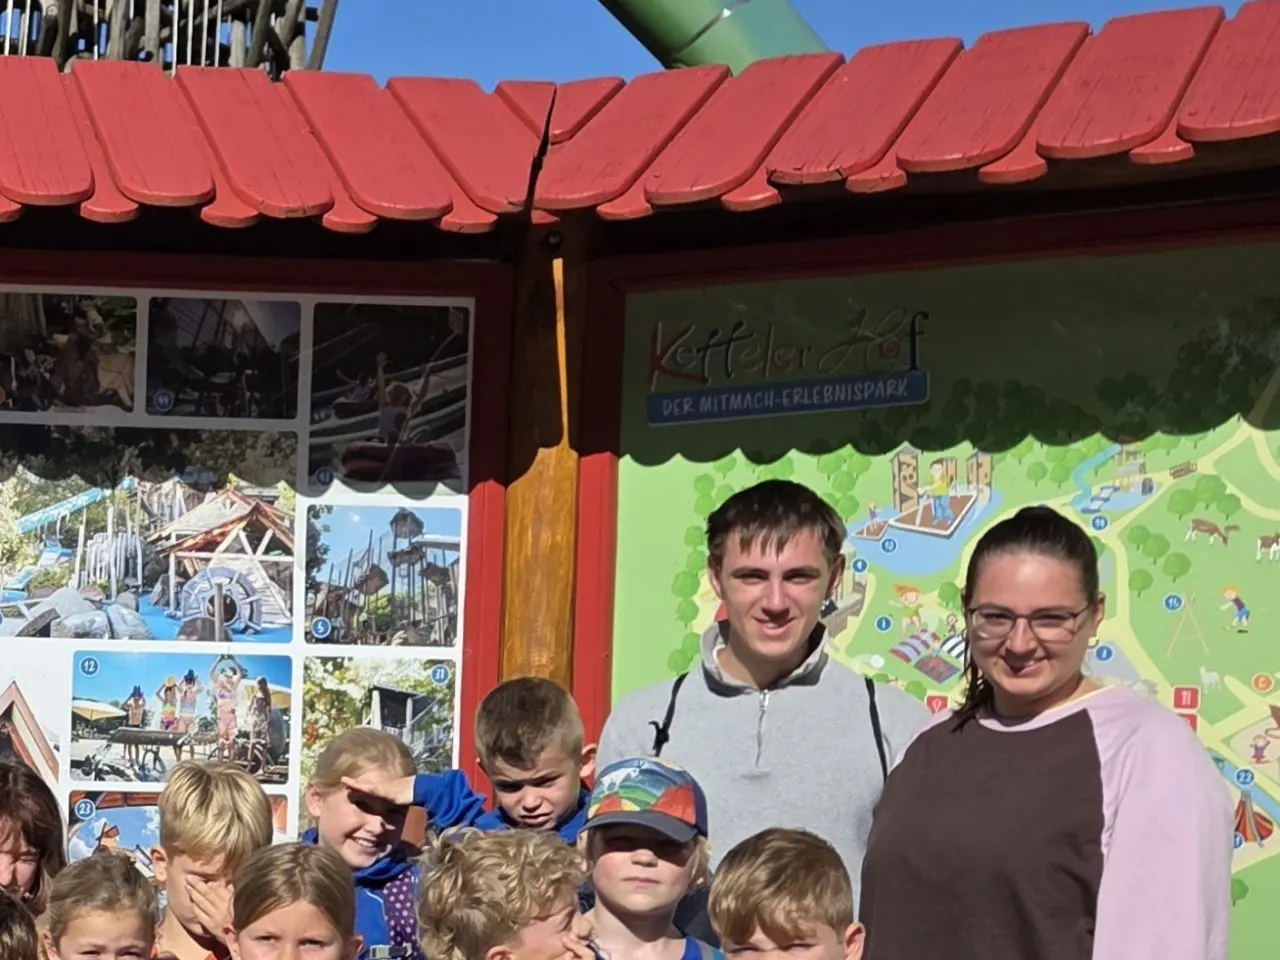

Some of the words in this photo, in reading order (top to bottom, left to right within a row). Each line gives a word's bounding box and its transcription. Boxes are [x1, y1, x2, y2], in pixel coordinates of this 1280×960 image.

[648, 320, 813, 391] Ketteler
[818, 307, 930, 372] Hof
[663, 397, 696, 416] DER
[698, 379, 908, 413] MITMACH-ERLEBNISPARK
[84, 660, 95, 672] 12
[79, 803, 91, 815] 23
